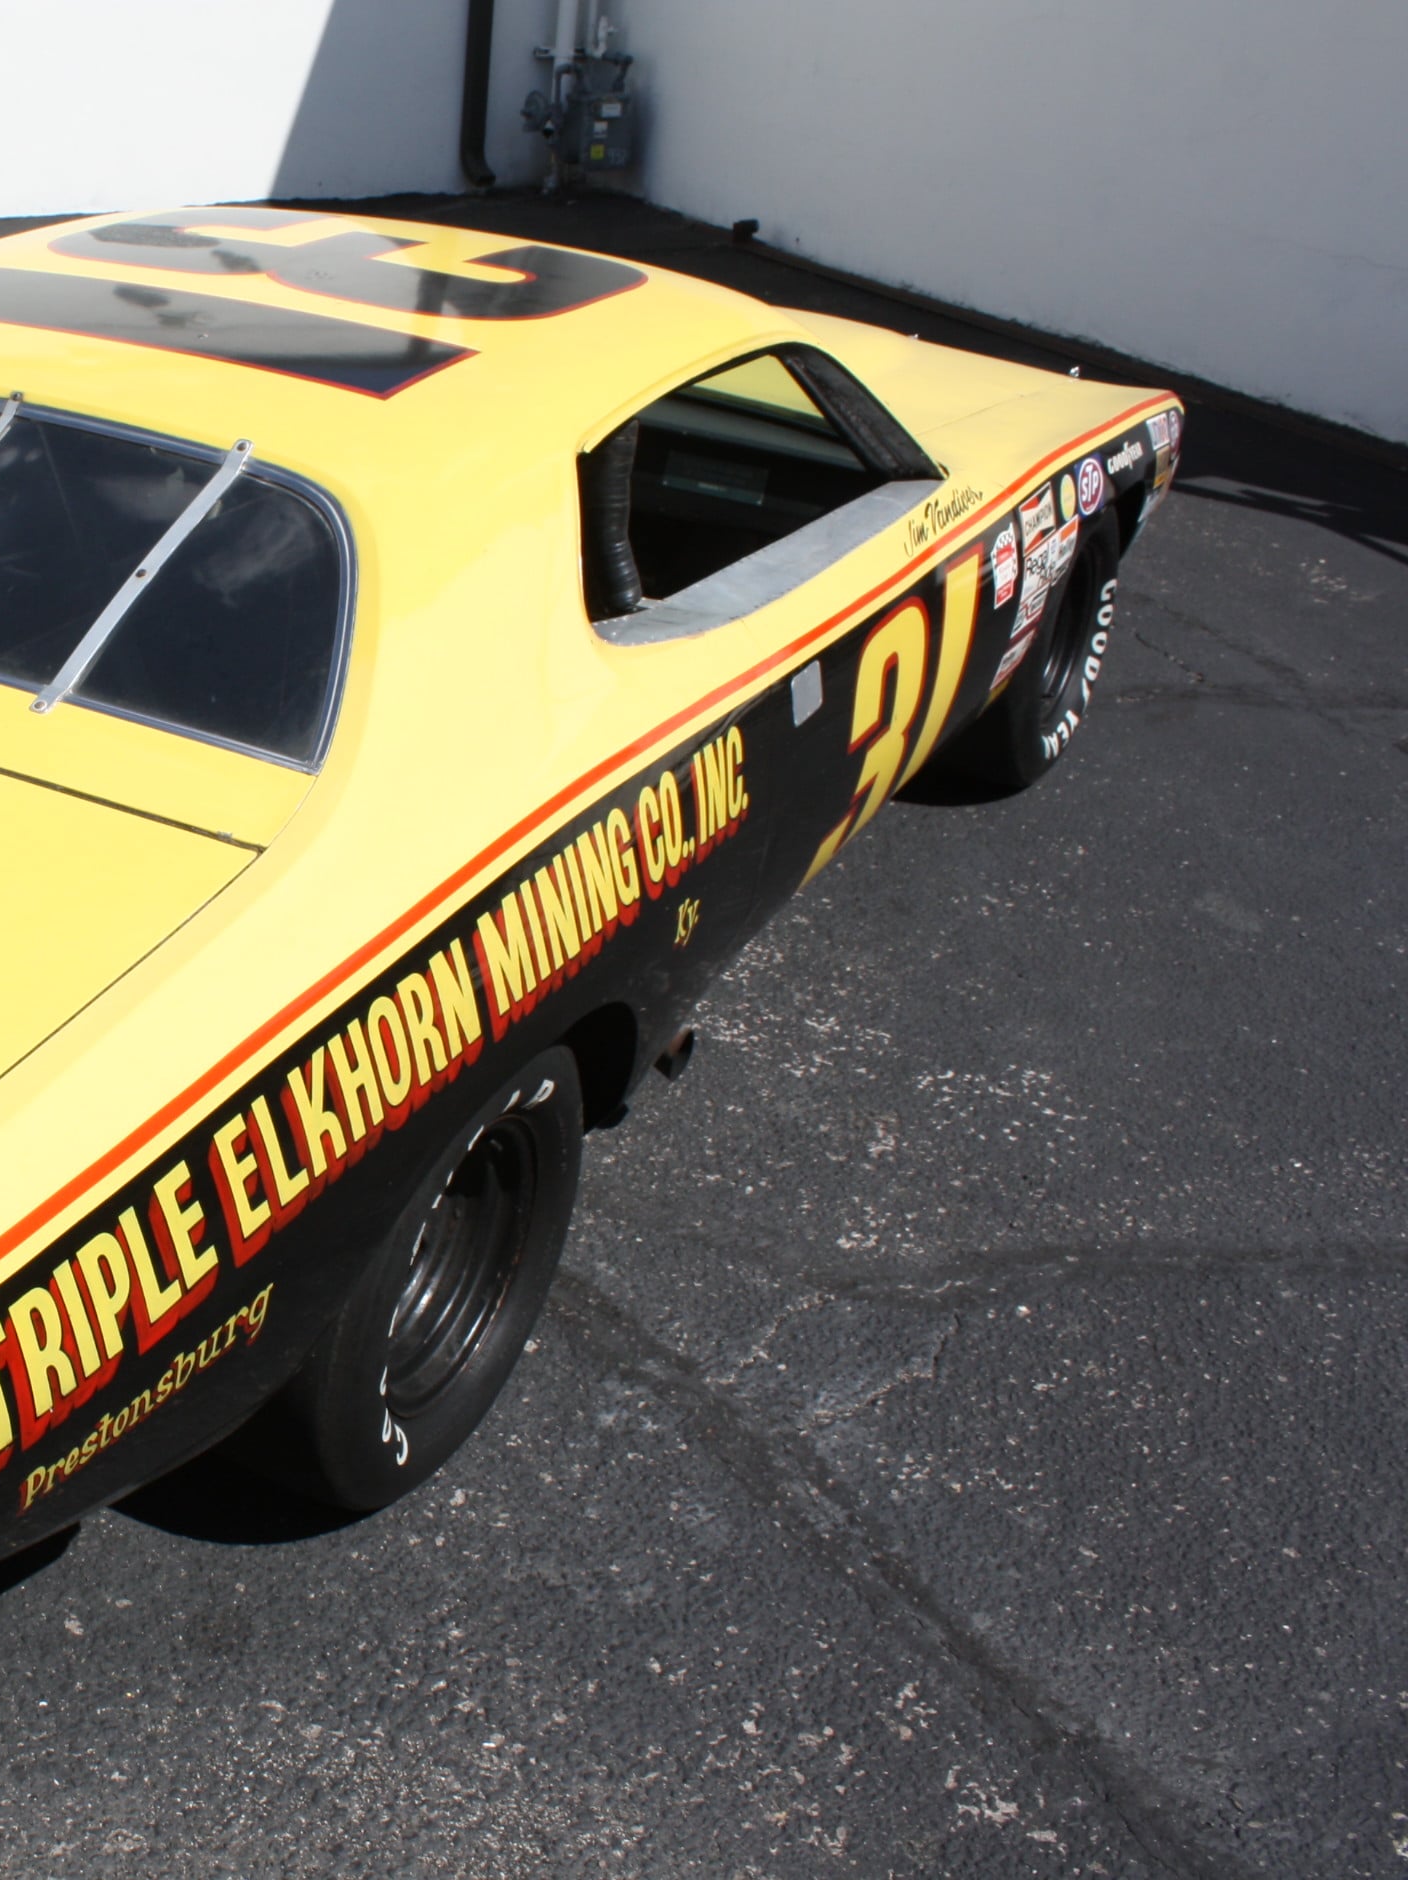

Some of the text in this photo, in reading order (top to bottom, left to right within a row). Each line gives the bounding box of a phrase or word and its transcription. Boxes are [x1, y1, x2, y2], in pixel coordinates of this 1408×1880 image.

[1107, 441, 1144, 475] GOODYEAR
[1081, 464, 1100, 502] STP
[904, 519, 929, 557] Jim
[1024, 502, 1052, 537] CHAMPION
[797, 543, 983, 892] 31
[210, 938, 483, 1250] ELKHORN
[475, 808, 640, 1028] MINING
[692, 726, 749, 856] INC.
[20, 1283, 274, 1511] Prestonsburg
